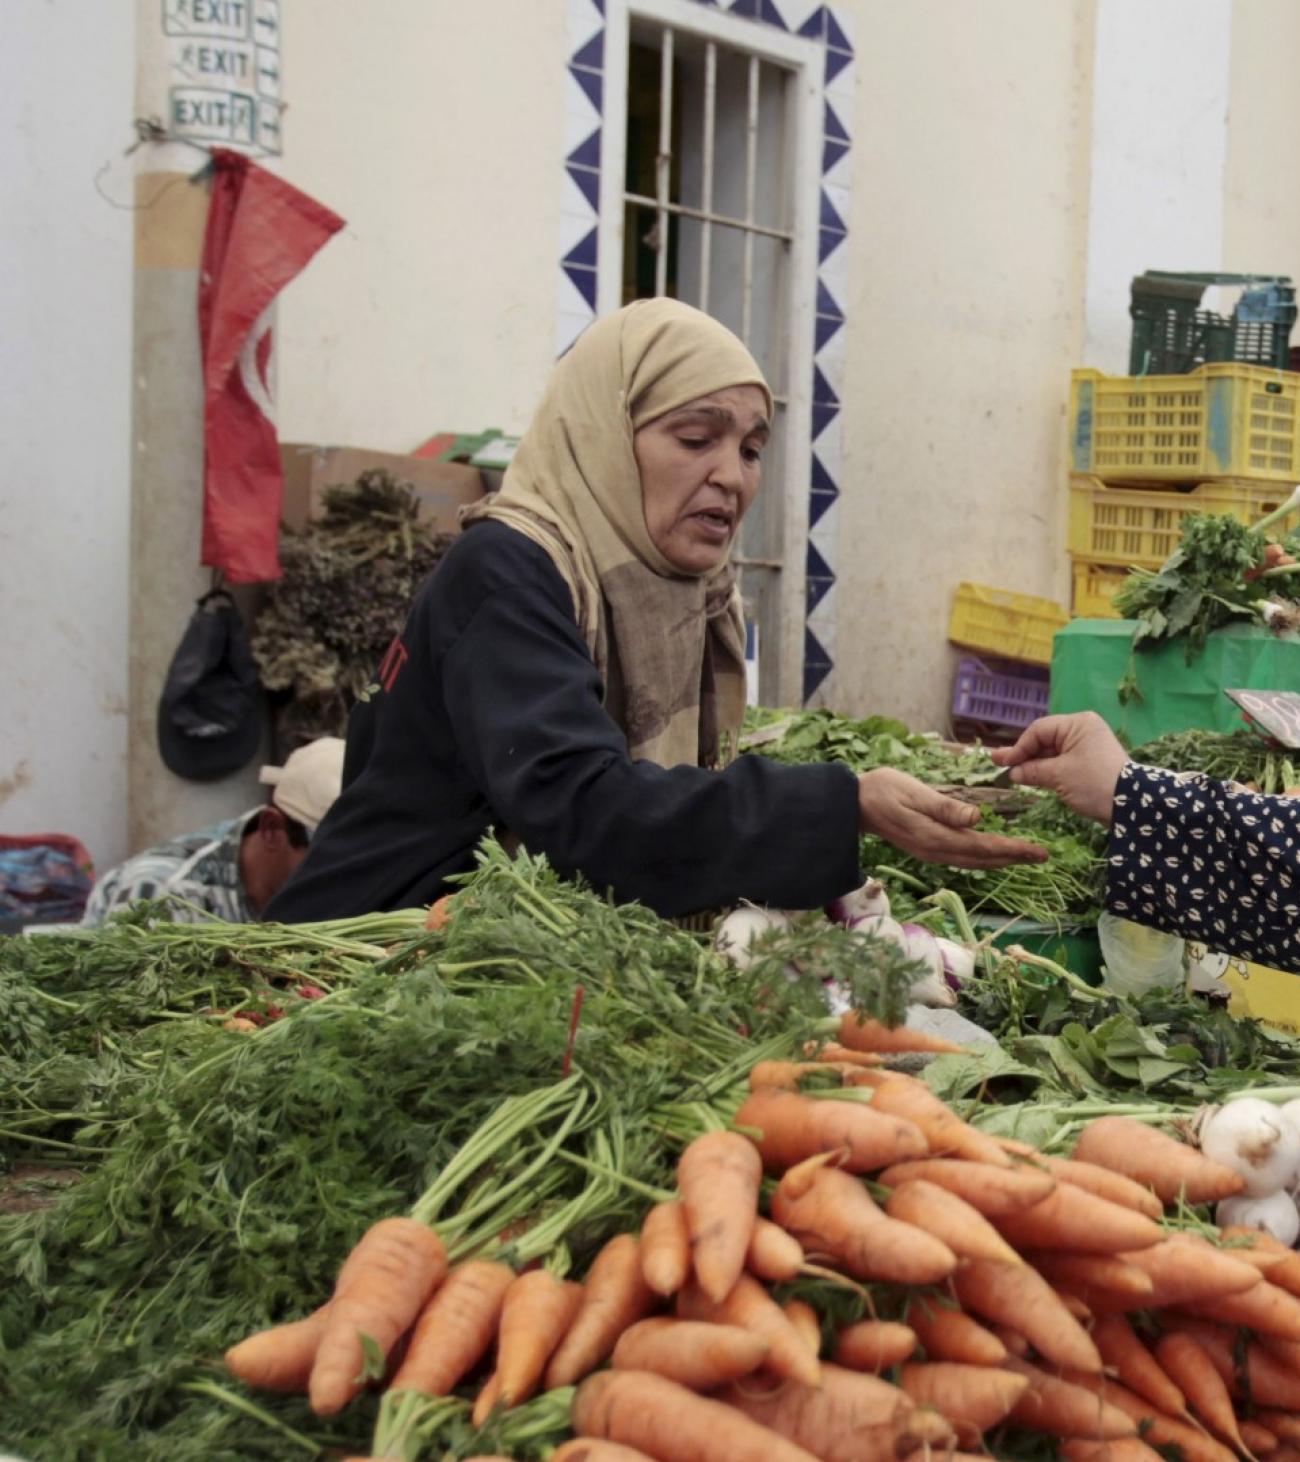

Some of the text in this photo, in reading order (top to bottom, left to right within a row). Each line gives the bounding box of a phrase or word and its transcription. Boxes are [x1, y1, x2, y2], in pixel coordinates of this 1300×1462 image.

[192, 0, 244, 27] EXIT
[198, 47, 248, 77] EXIT
[174, 99, 227, 127] EXIT
